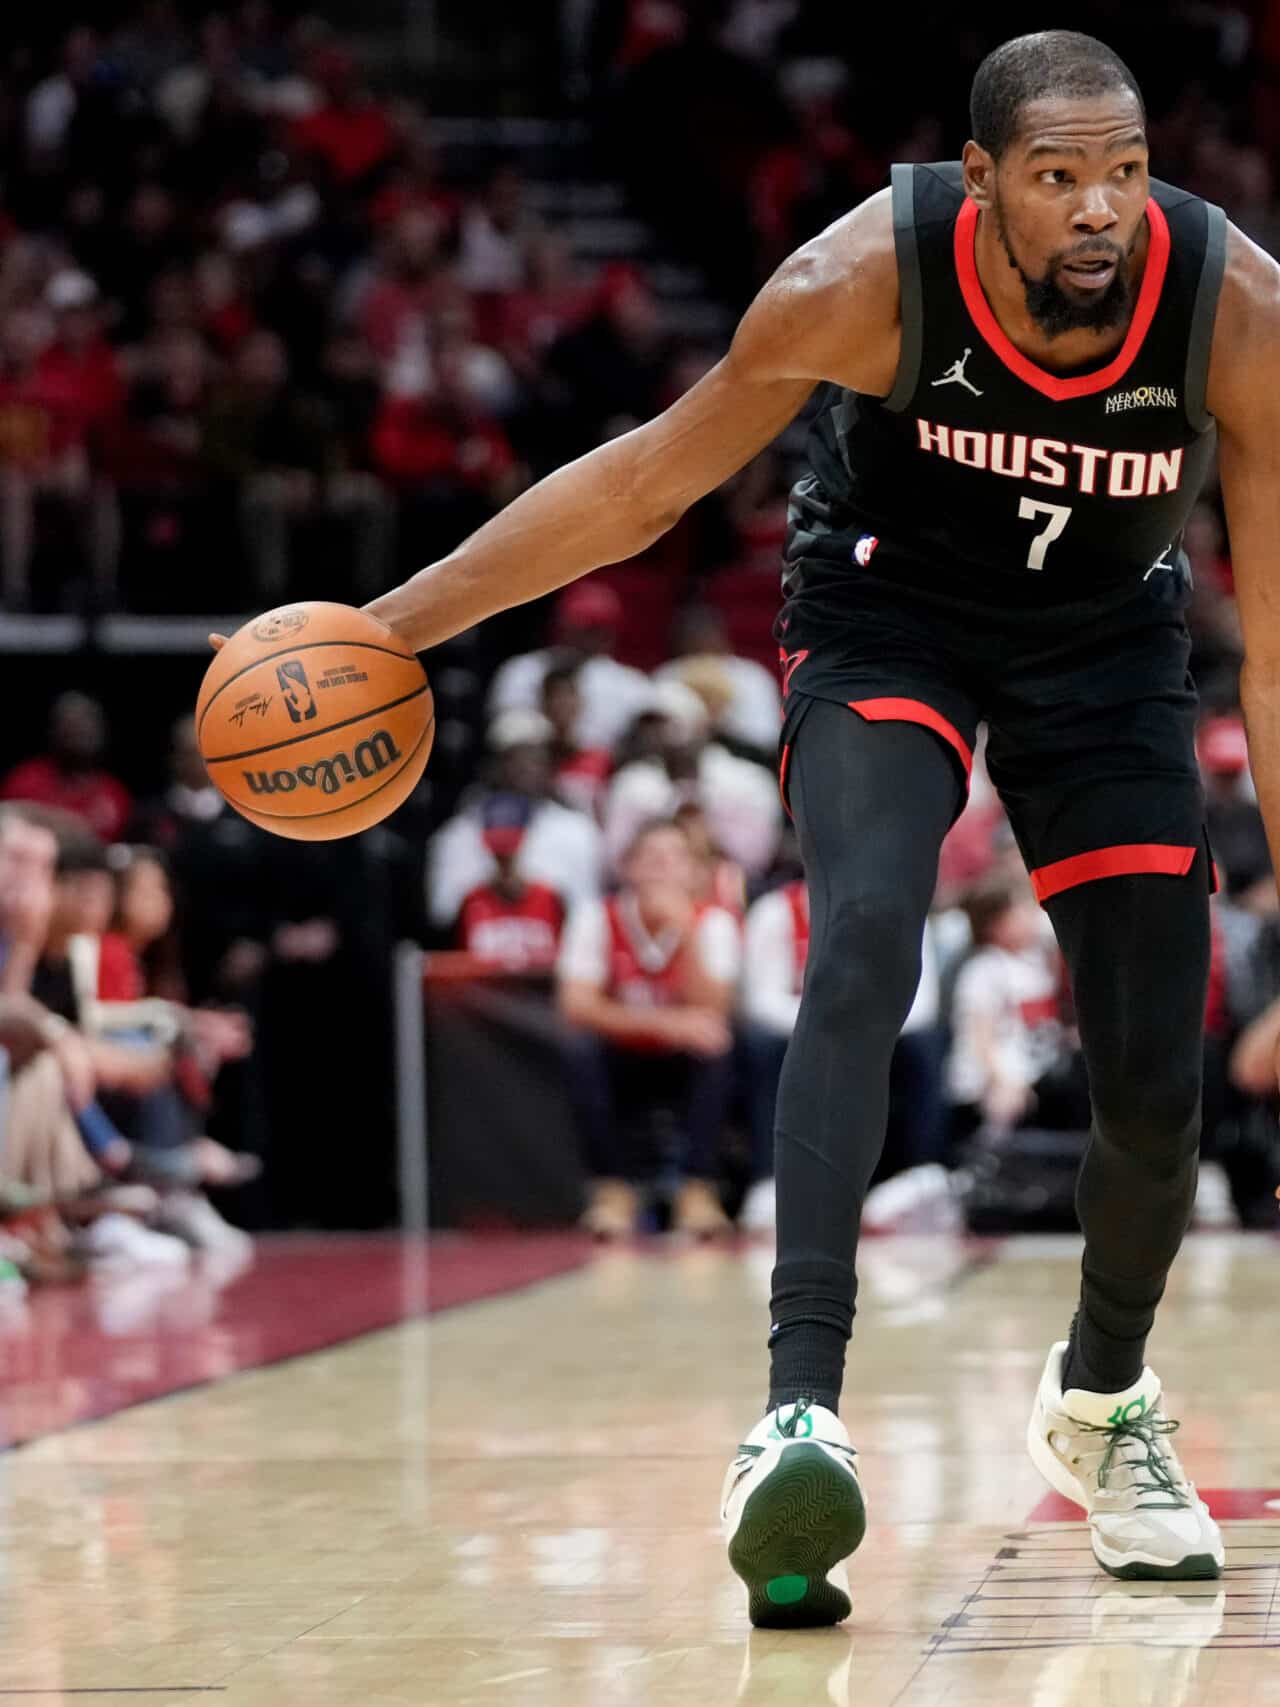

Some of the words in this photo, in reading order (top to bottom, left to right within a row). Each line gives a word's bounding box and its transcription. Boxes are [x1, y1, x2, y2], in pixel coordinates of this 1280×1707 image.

[1105, 386, 1177, 405] MEMORIAL
[1105, 397, 1177, 414] HERMANN
[916, 418, 1185, 498] HOUSTON
[1018, 496, 1072, 570] 7
[242, 729, 402, 795] Wilson
